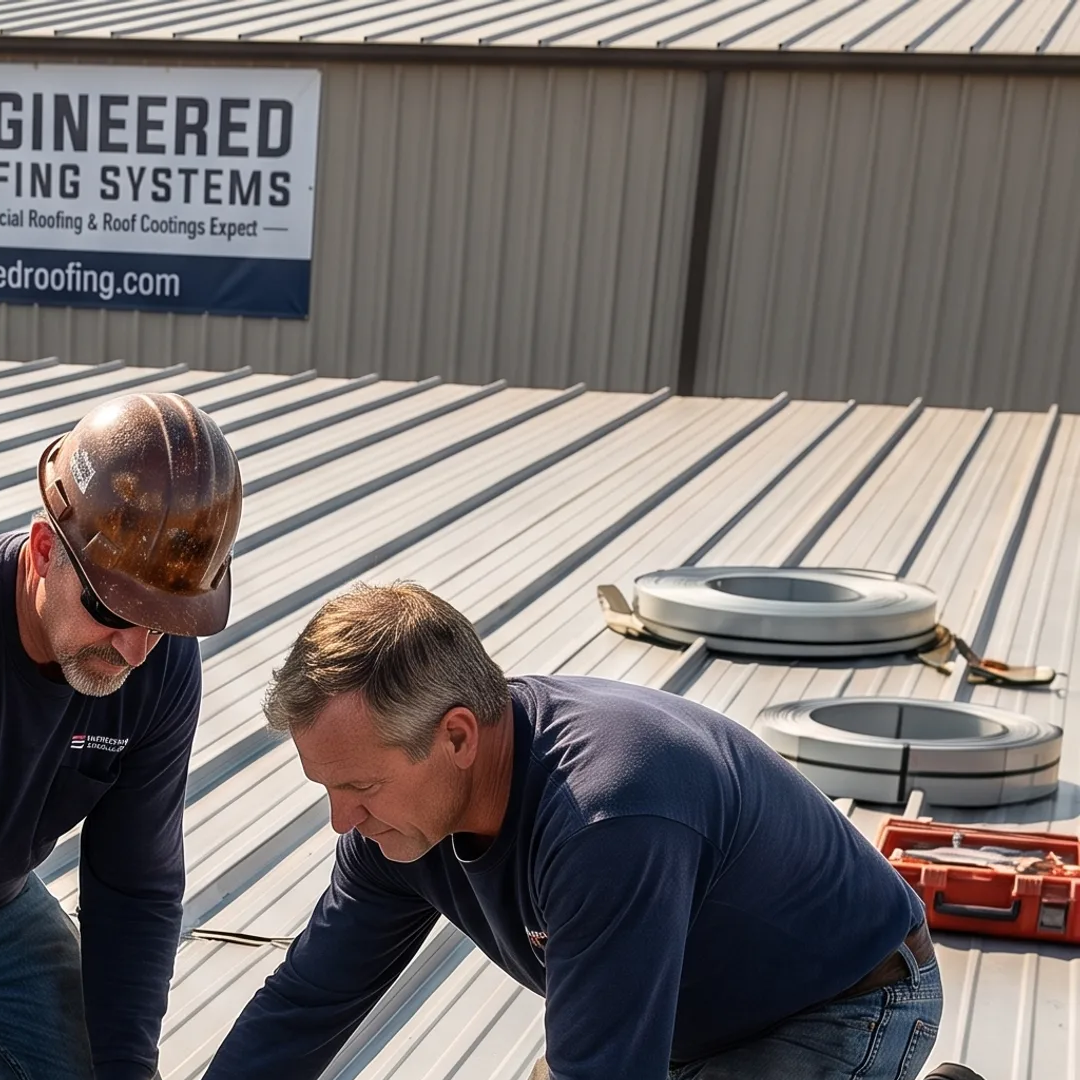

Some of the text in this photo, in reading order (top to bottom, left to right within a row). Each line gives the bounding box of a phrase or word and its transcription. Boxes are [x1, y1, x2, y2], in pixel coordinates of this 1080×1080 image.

[100, 165, 291, 207] SYSTEMS
[28, 209, 83, 235] Roofing
[87, 213, 98, 231] &
[103, 212, 137, 232] Roof
